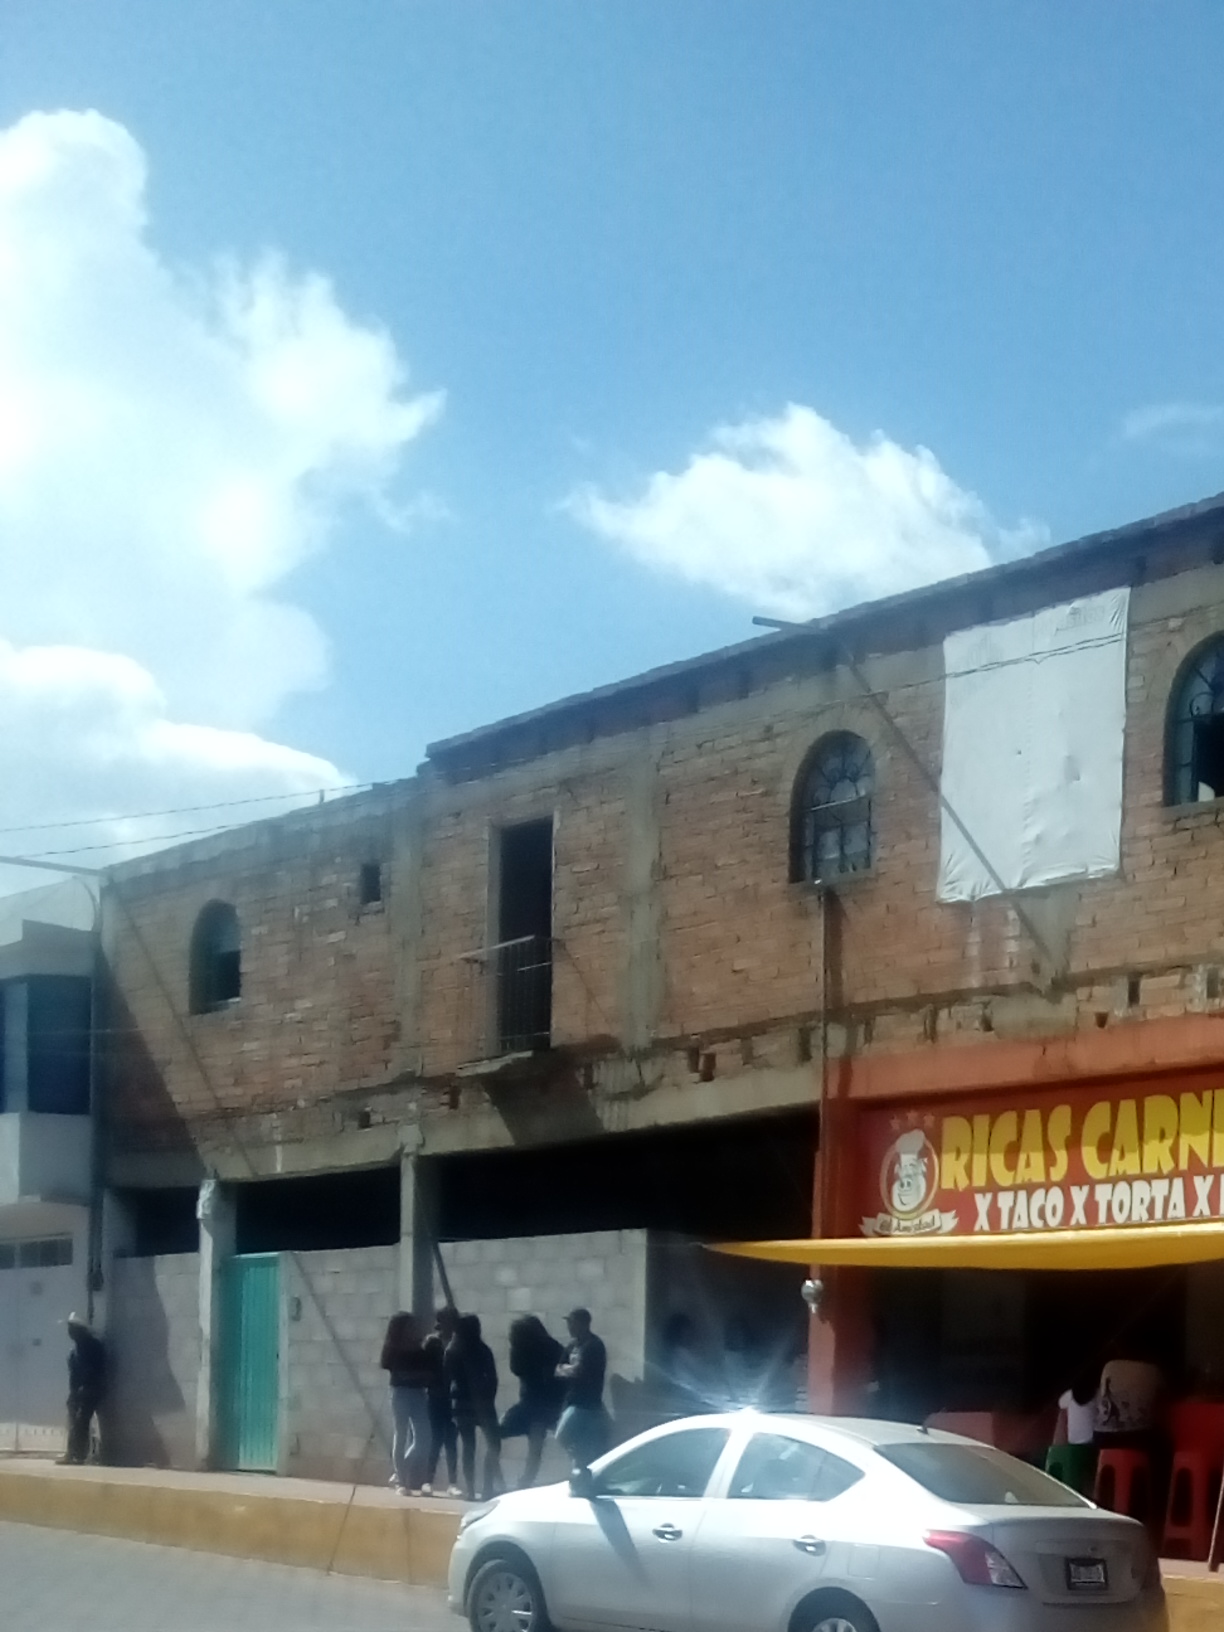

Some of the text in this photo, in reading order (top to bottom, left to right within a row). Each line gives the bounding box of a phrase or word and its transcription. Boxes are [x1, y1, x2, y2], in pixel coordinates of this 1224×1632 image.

[941, 1105, 1072, 1191] RICAS
[973, 1192, 993, 1232] X
[997, 1186, 1065, 1230] TACO
[1070, 1184, 1090, 1226] X
[1094, 1177, 1186, 1225] TORTA
[1193, 1174, 1215, 1217] X
